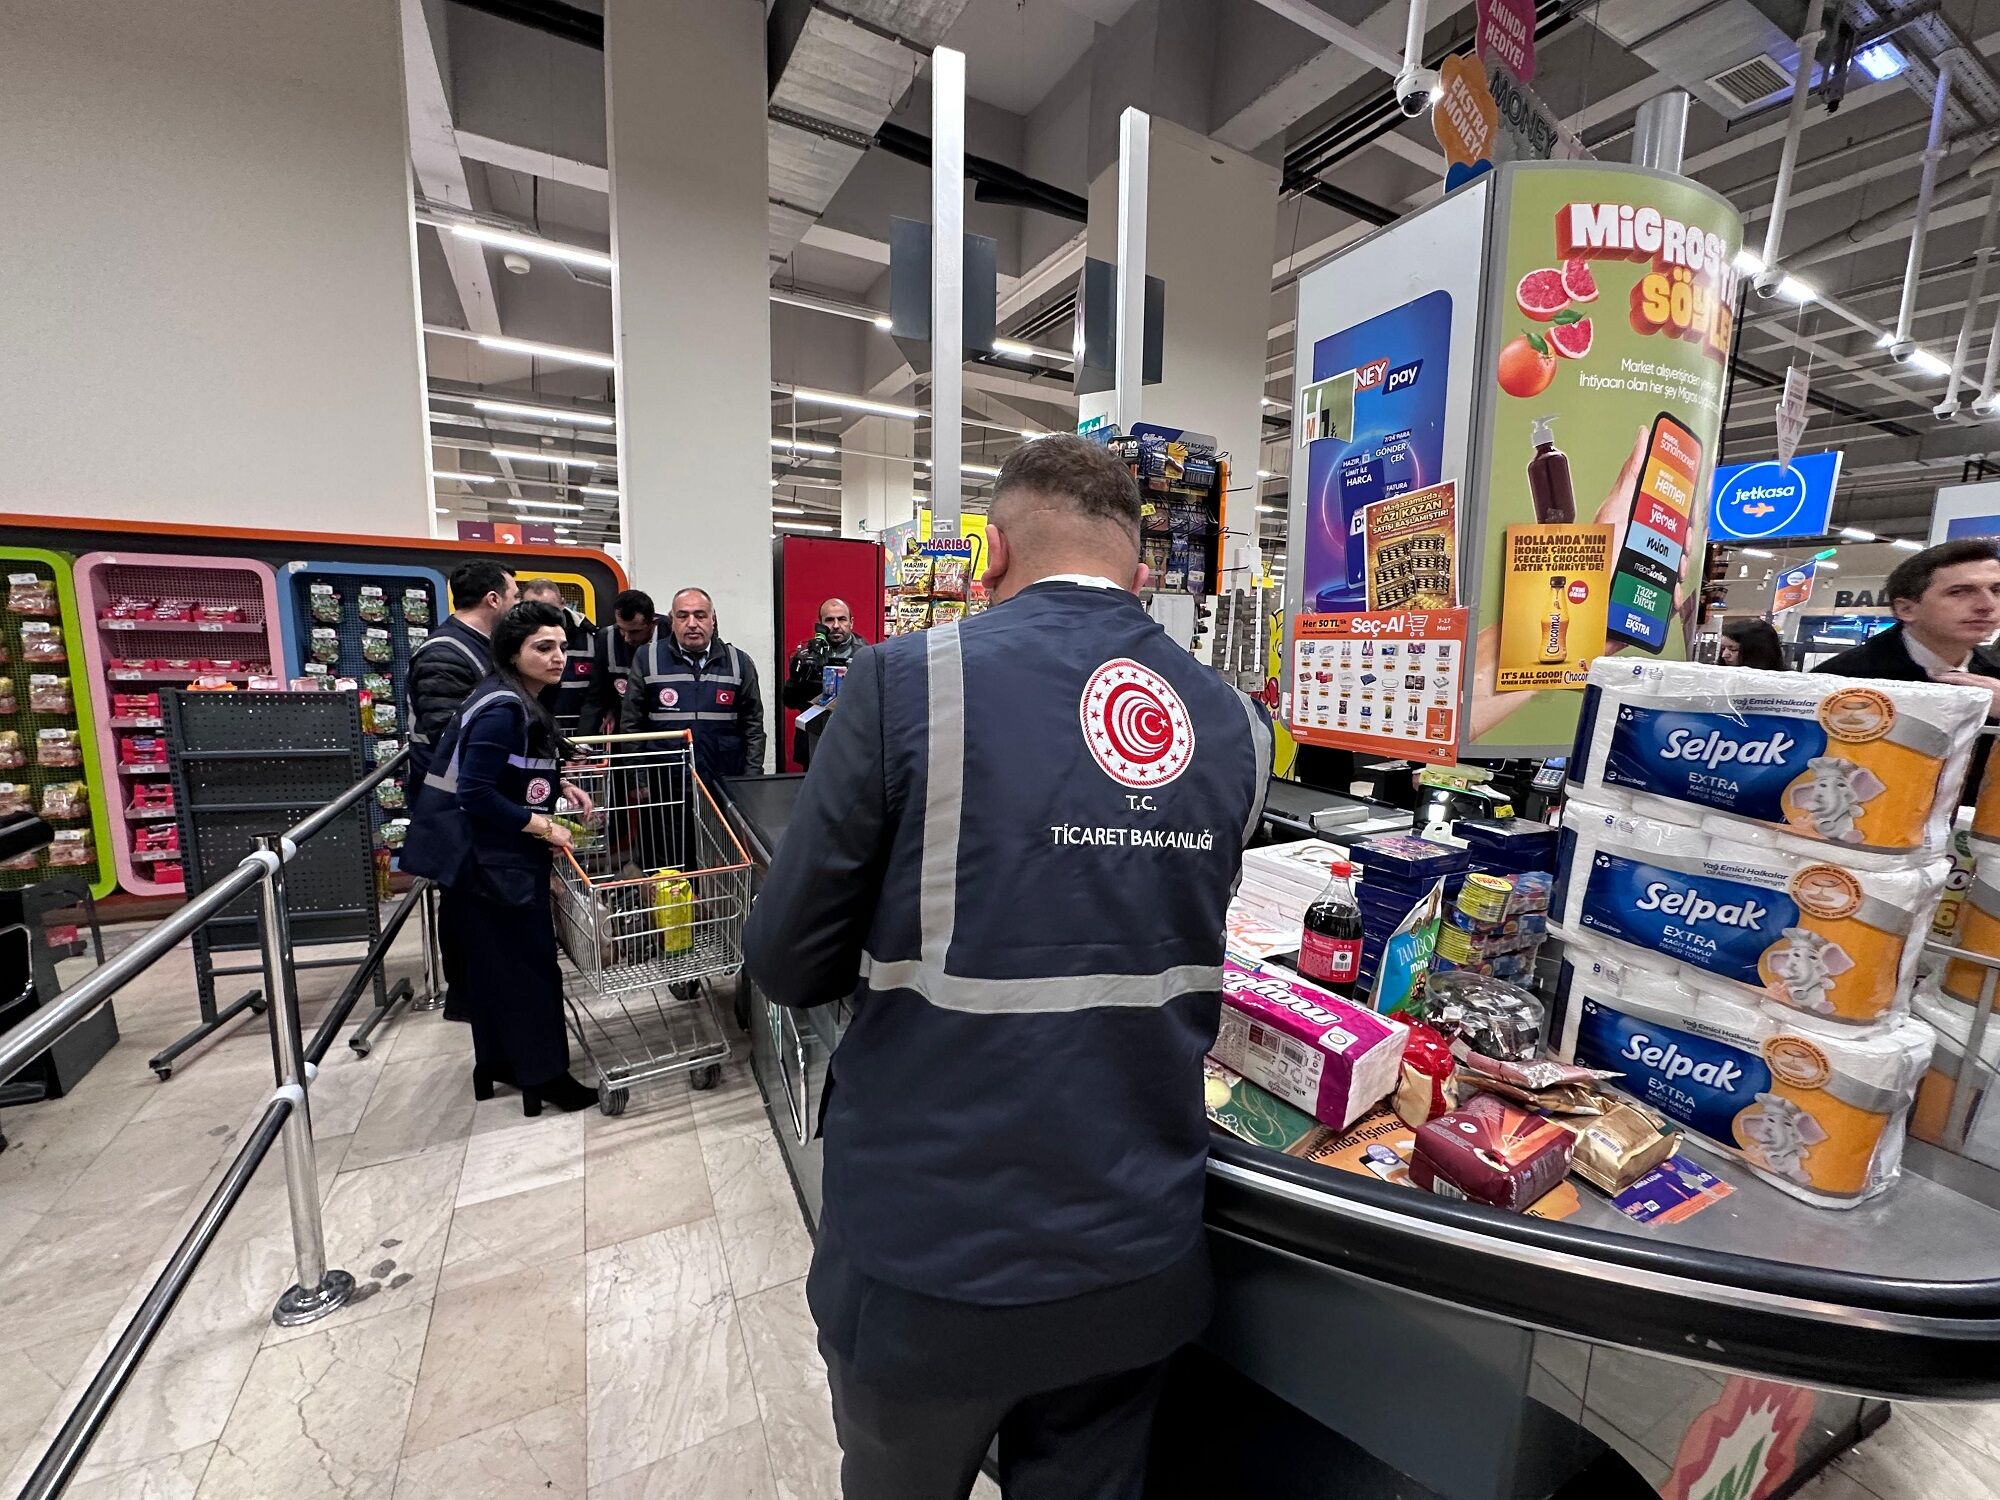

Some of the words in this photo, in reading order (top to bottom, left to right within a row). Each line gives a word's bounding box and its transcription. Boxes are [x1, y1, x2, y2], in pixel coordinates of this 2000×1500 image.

[1488, 0, 1527, 45] ANINDA
[1485, 20, 1525, 70] HEDİYE!
[1451, 74, 1489, 143] EKSTRA
[1489, 67, 1558, 159] MONEY
[1443, 94, 1483, 161] MONEY!
[1621, 358, 1654, 375] Market
[1389, 366, 1418, 391] pay
[1628, 378, 1648, 391] olan
[1649, 380, 1663, 393] her
[1127, 440, 1137, 449] 10
[1346, 474, 1372, 487] HARCA
[1386, 482, 1408, 491] FATURA
[1654, 476, 1686, 506] Hemen
[1730, 485, 1795, 505] jetkasa
[1377, 511, 1399, 525] KAZI
[1402, 500, 1442, 517] KAZAN
[1649, 508, 1677, 533] yemek
[927, 539, 972, 551] HARIBO
[1514, 534, 1606, 546] HOLLANDA'NIN
[1514, 563, 1543, 572] ARTIK
[1552, 554, 1604, 563] CHOCOMEL
[1633, 594, 1656, 612] Direkt
[1303, 620, 1316, 628] Her
[1318, 619, 1329, 628] 50
[1351, 615, 1405, 637] Seç-Al
[1625, 618, 1650, 636] EKSTRA
[1546, 613, 1560, 654] Chocomel
[1501, 672, 1518, 680] IT'S
[1536, 671, 1563, 679] GOOD!
[1632, 665, 1642, 676] 8
[1749, 698, 1774, 706] Emici
[1775, 699, 1817, 708] Halkalar
[1659, 729, 1794, 770] Selpak
[1688, 771, 1739, 793] EXTRA
[1126, 795, 1157, 811] T.C.
[1605, 815, 1614, 825] 8
[1051, 824, 1127, 846] TİCARET
[1130, 829, 1213, 850] BAKANLIĞI
[1720, 864, 1747, 874] Emici
[1748, 867, 1789, 880] Halkalar
[1636, 881, 1766, 930] Selpak
[1662, 925, 1717, 951] EXTRA
[1410, 958, 1428, 974] mini
[1593, 963, 1601, 973] 8
[1621, 1033, 1742, 1092] Selpak
[1648, 1077, 1696, 1108] EXTRA
[1360, 1120, 1404, 1140] fişinize
